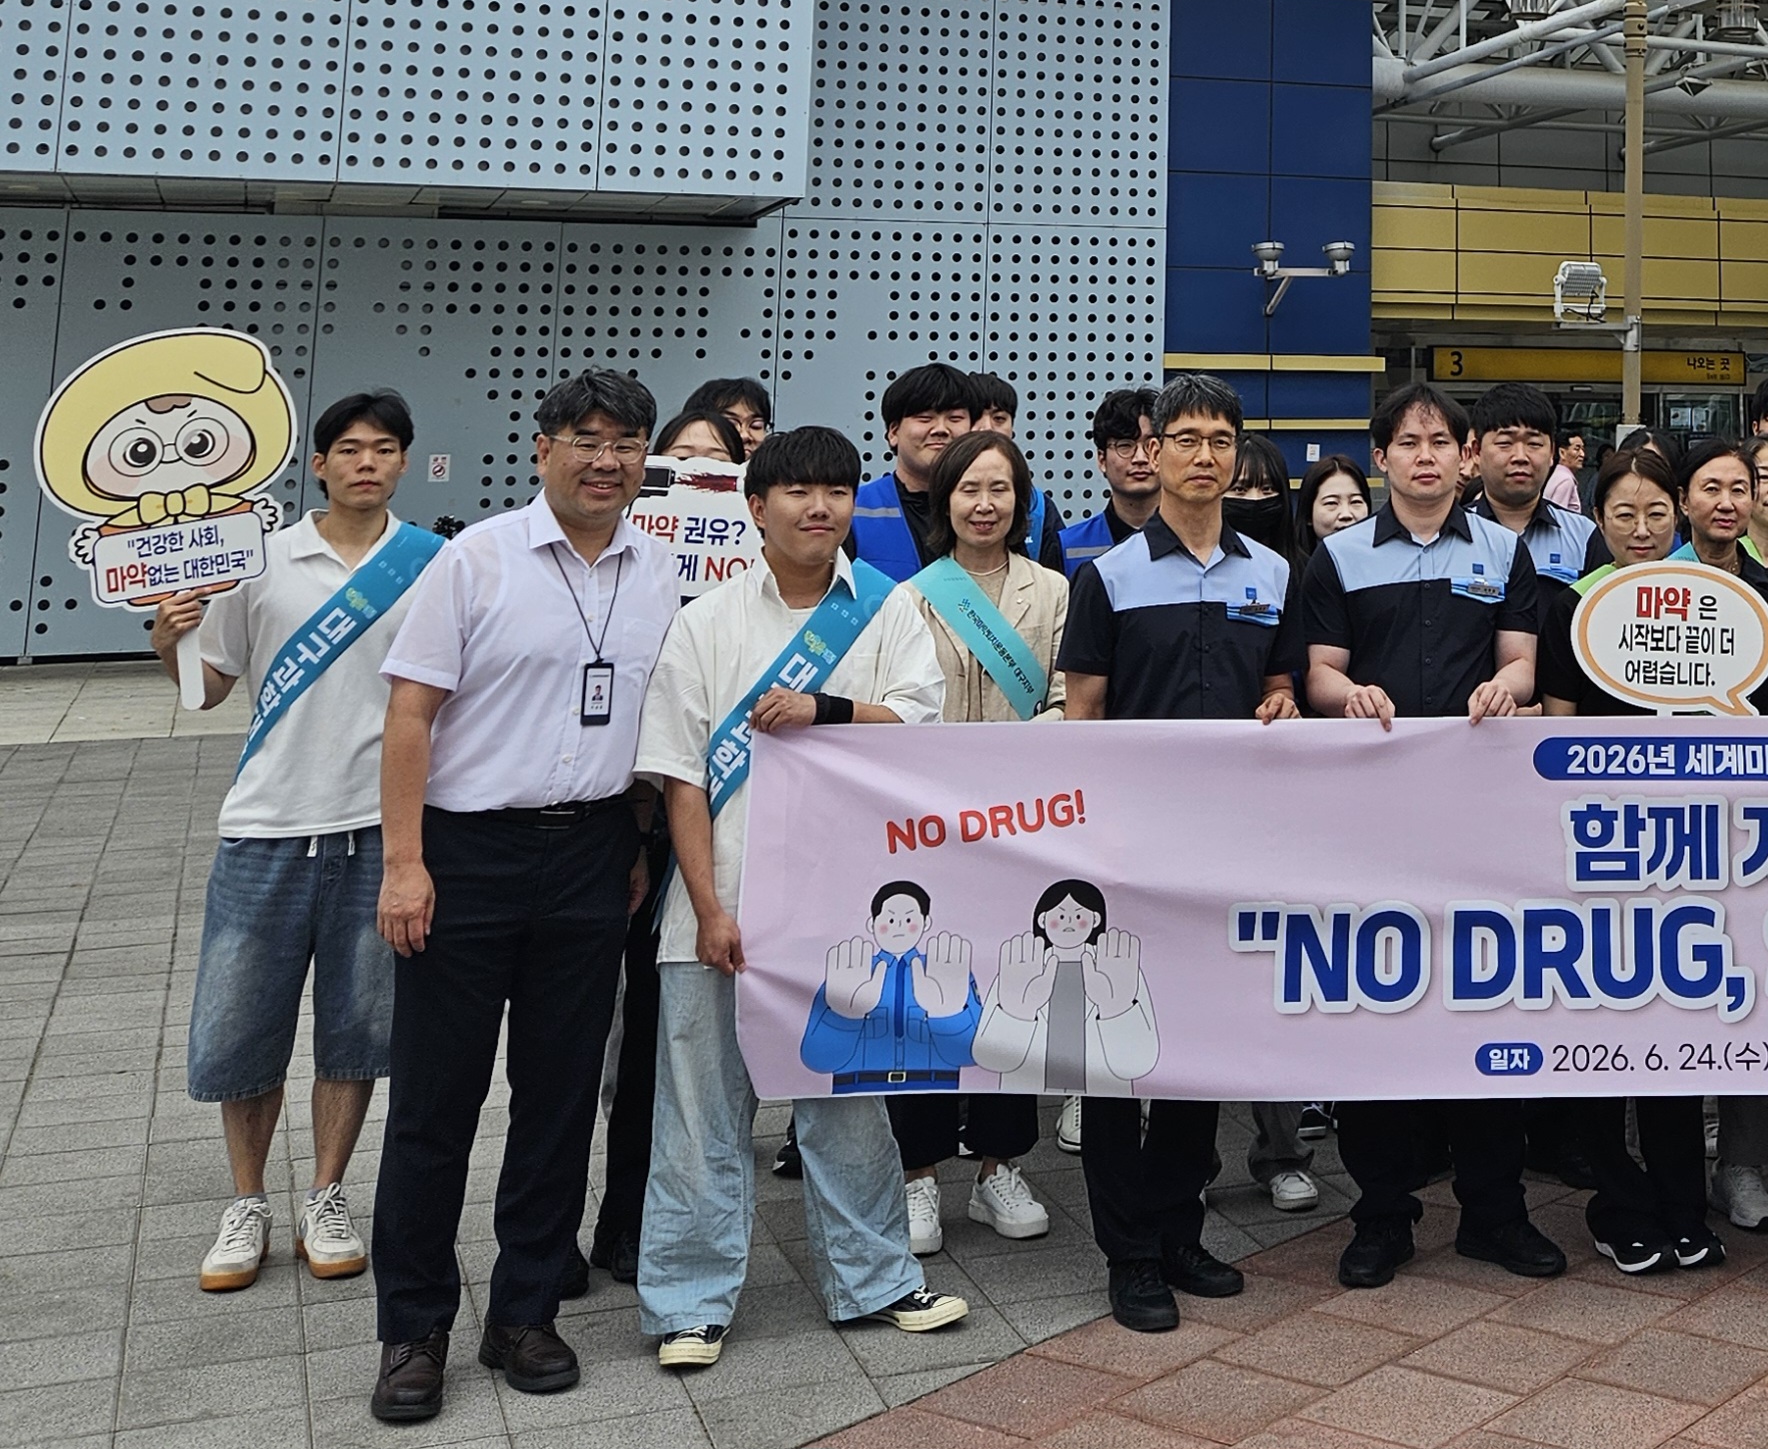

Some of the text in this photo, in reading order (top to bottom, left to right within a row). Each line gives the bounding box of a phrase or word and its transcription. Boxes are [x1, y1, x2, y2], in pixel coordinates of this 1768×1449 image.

[1450, 351, 1463, 377] 3
[1687, 356, 1731, 371] 나오는 곳
[127, 524, 225, 559] "건강한 사회,
[684, 517, 746, 546] 권유?
[105, 549, 254, 593] 마약없는 대한민국"
[1636, 586, 1718, 621] 마약 은
[1618, 623, 1735, 656] 시작보다 끝이 더
[1625, 659, 1716, 687] 어렵습니다.
[1566, 743, 1676, 776] 2026년
[886, 788, 1086, 855] NO DRUG!
[1569, 802, 1719, 882] 함께
[1237, 909, 1422, 1004] "NO
[1451, 904, 1747, 1013] DRUG,
[1487, 1046, 1531, 1072] 일자
[1551, 1043, 1635, 1073] 2026.
[1643, 1043, 1669, 1073] 6.
